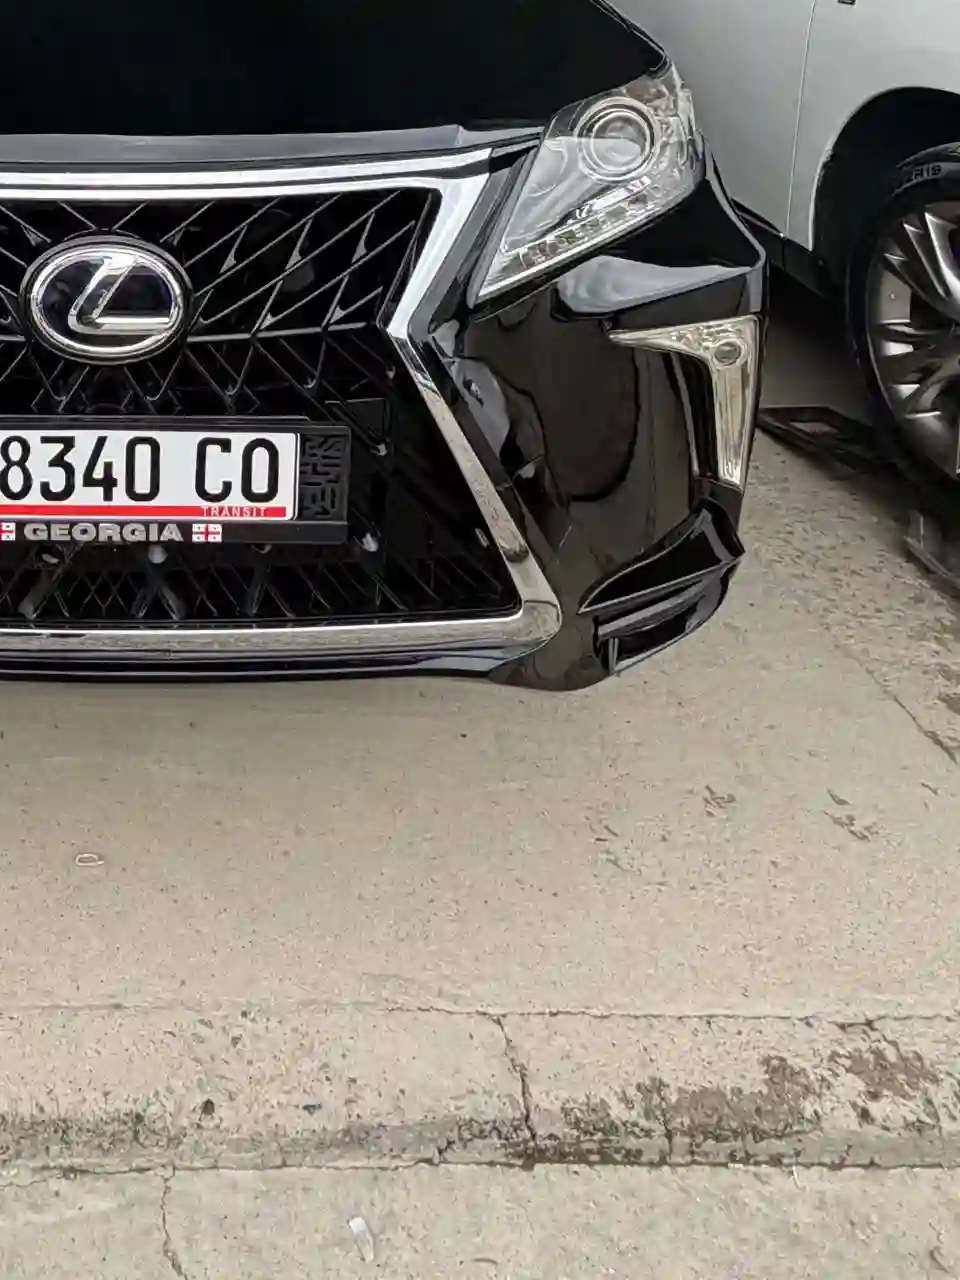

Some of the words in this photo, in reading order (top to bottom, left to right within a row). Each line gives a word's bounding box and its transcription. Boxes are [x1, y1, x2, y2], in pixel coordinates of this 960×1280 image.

[194, 437, 280, 504] CO
[201, 505, 267, 518] TRANSIT
[23, 522, 184, 543] GEORGIA
